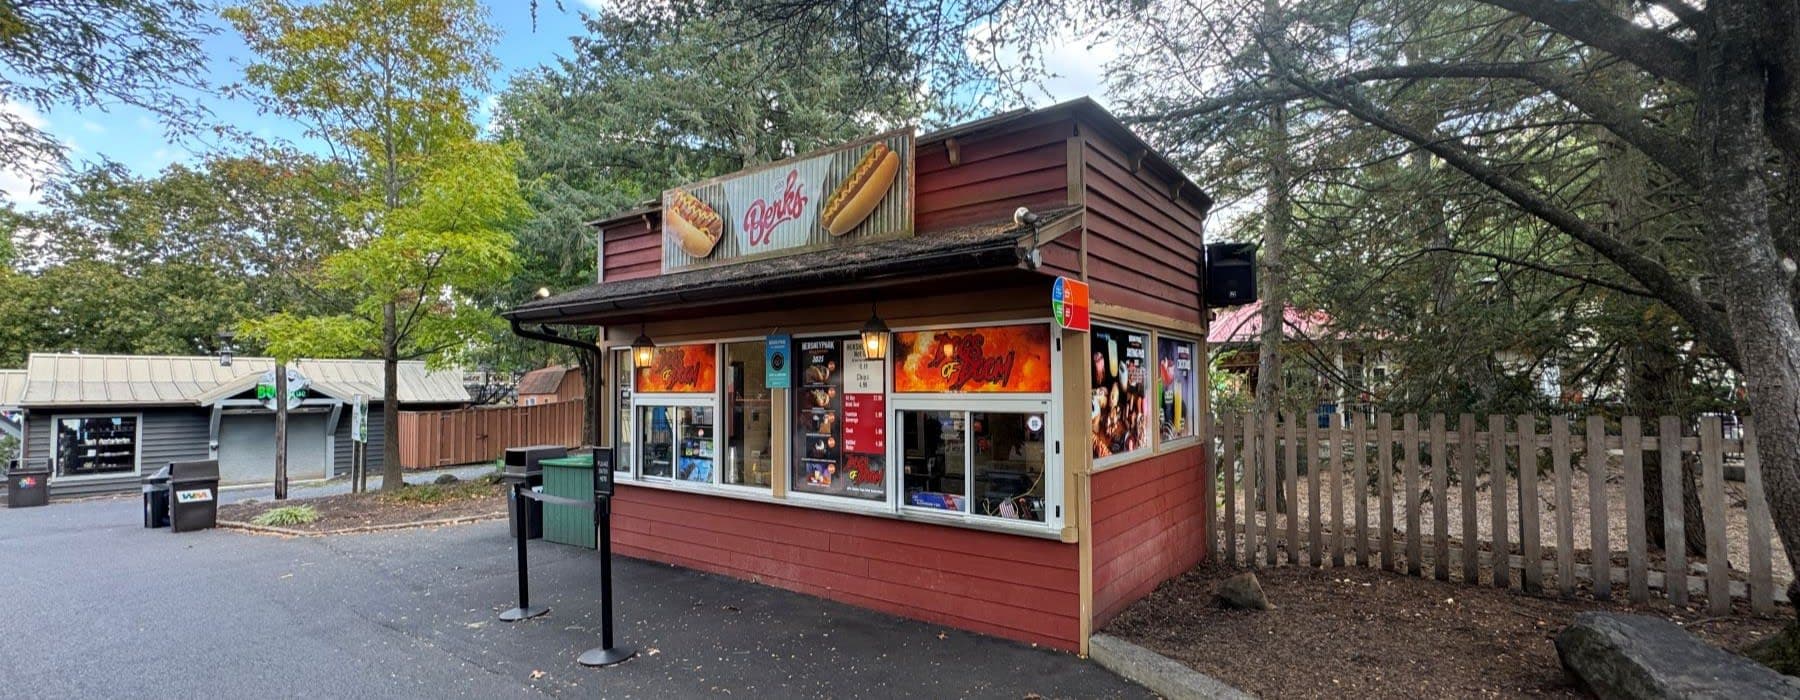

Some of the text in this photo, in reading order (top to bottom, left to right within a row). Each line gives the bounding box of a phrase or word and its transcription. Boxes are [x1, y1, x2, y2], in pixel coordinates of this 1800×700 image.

[743, 169, 808, 246] Berks
[801, 340, 835, 350] HERSHEYPARK
[941, 361, 961, 378] OF
